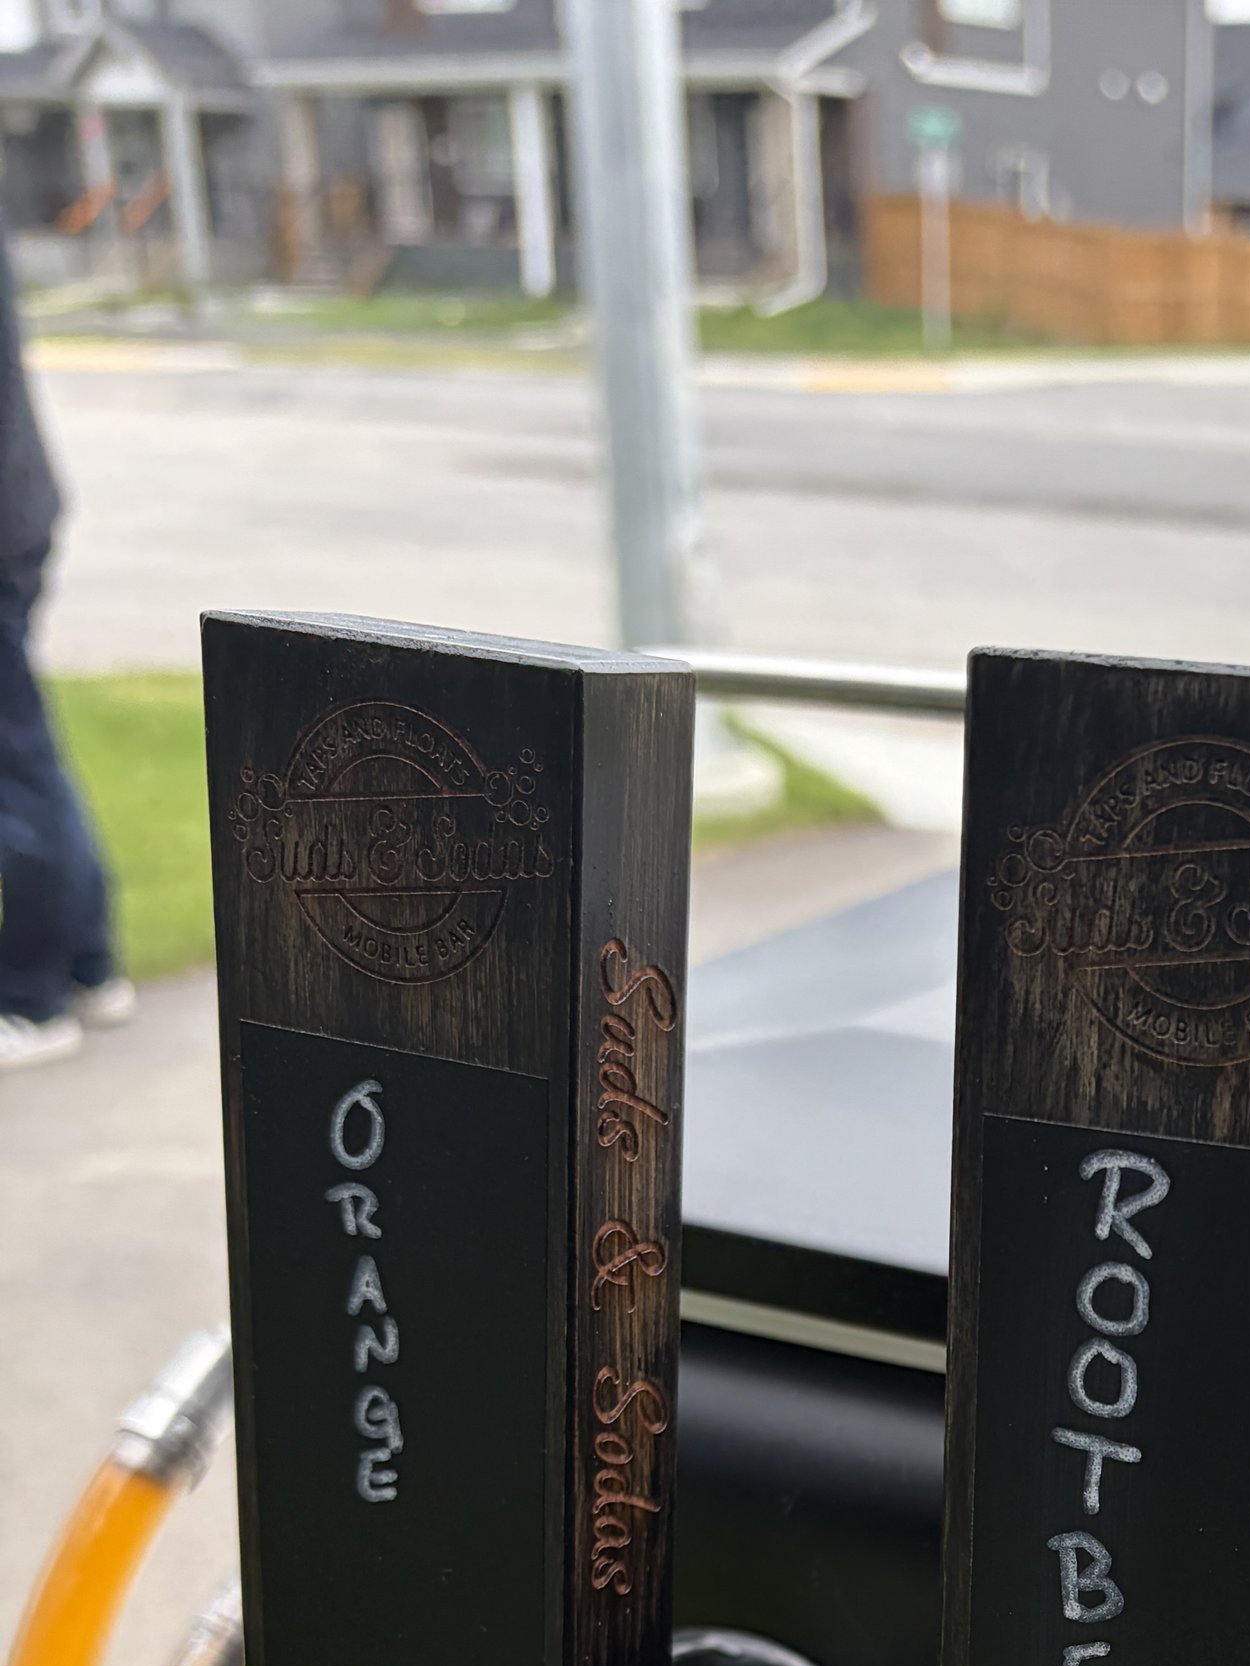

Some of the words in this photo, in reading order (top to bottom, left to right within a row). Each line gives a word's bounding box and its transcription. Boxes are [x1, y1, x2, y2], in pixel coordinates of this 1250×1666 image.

[297, 735, 340, 791] TAPS
[342, 717, 386, 750] AND
[391, 718, 470, 787] FLOATS
[245, 814, 357, 884] Suds
[367, 804, 413, 885] &
[415, 813, 555, 883] Sodas
[1079, 782, 1139, 846] TAPS
[1143, 759, 1203, 796] AND
[342, 924, 431, 969] MOBILE
[436, 918, 478, 962] BAR
[1005, 881, 1154, 957] Suds
[1165, 862, 1226, 952] &
[597, 937, 676, 1163] Suds
[1127, 1000, 1239, 1048] MOBILE
[324, 1079, 404, 1503] ORANGE
[591, 1219, 667, 1314] &
[591, 1365, 669, 1596] Sodas
